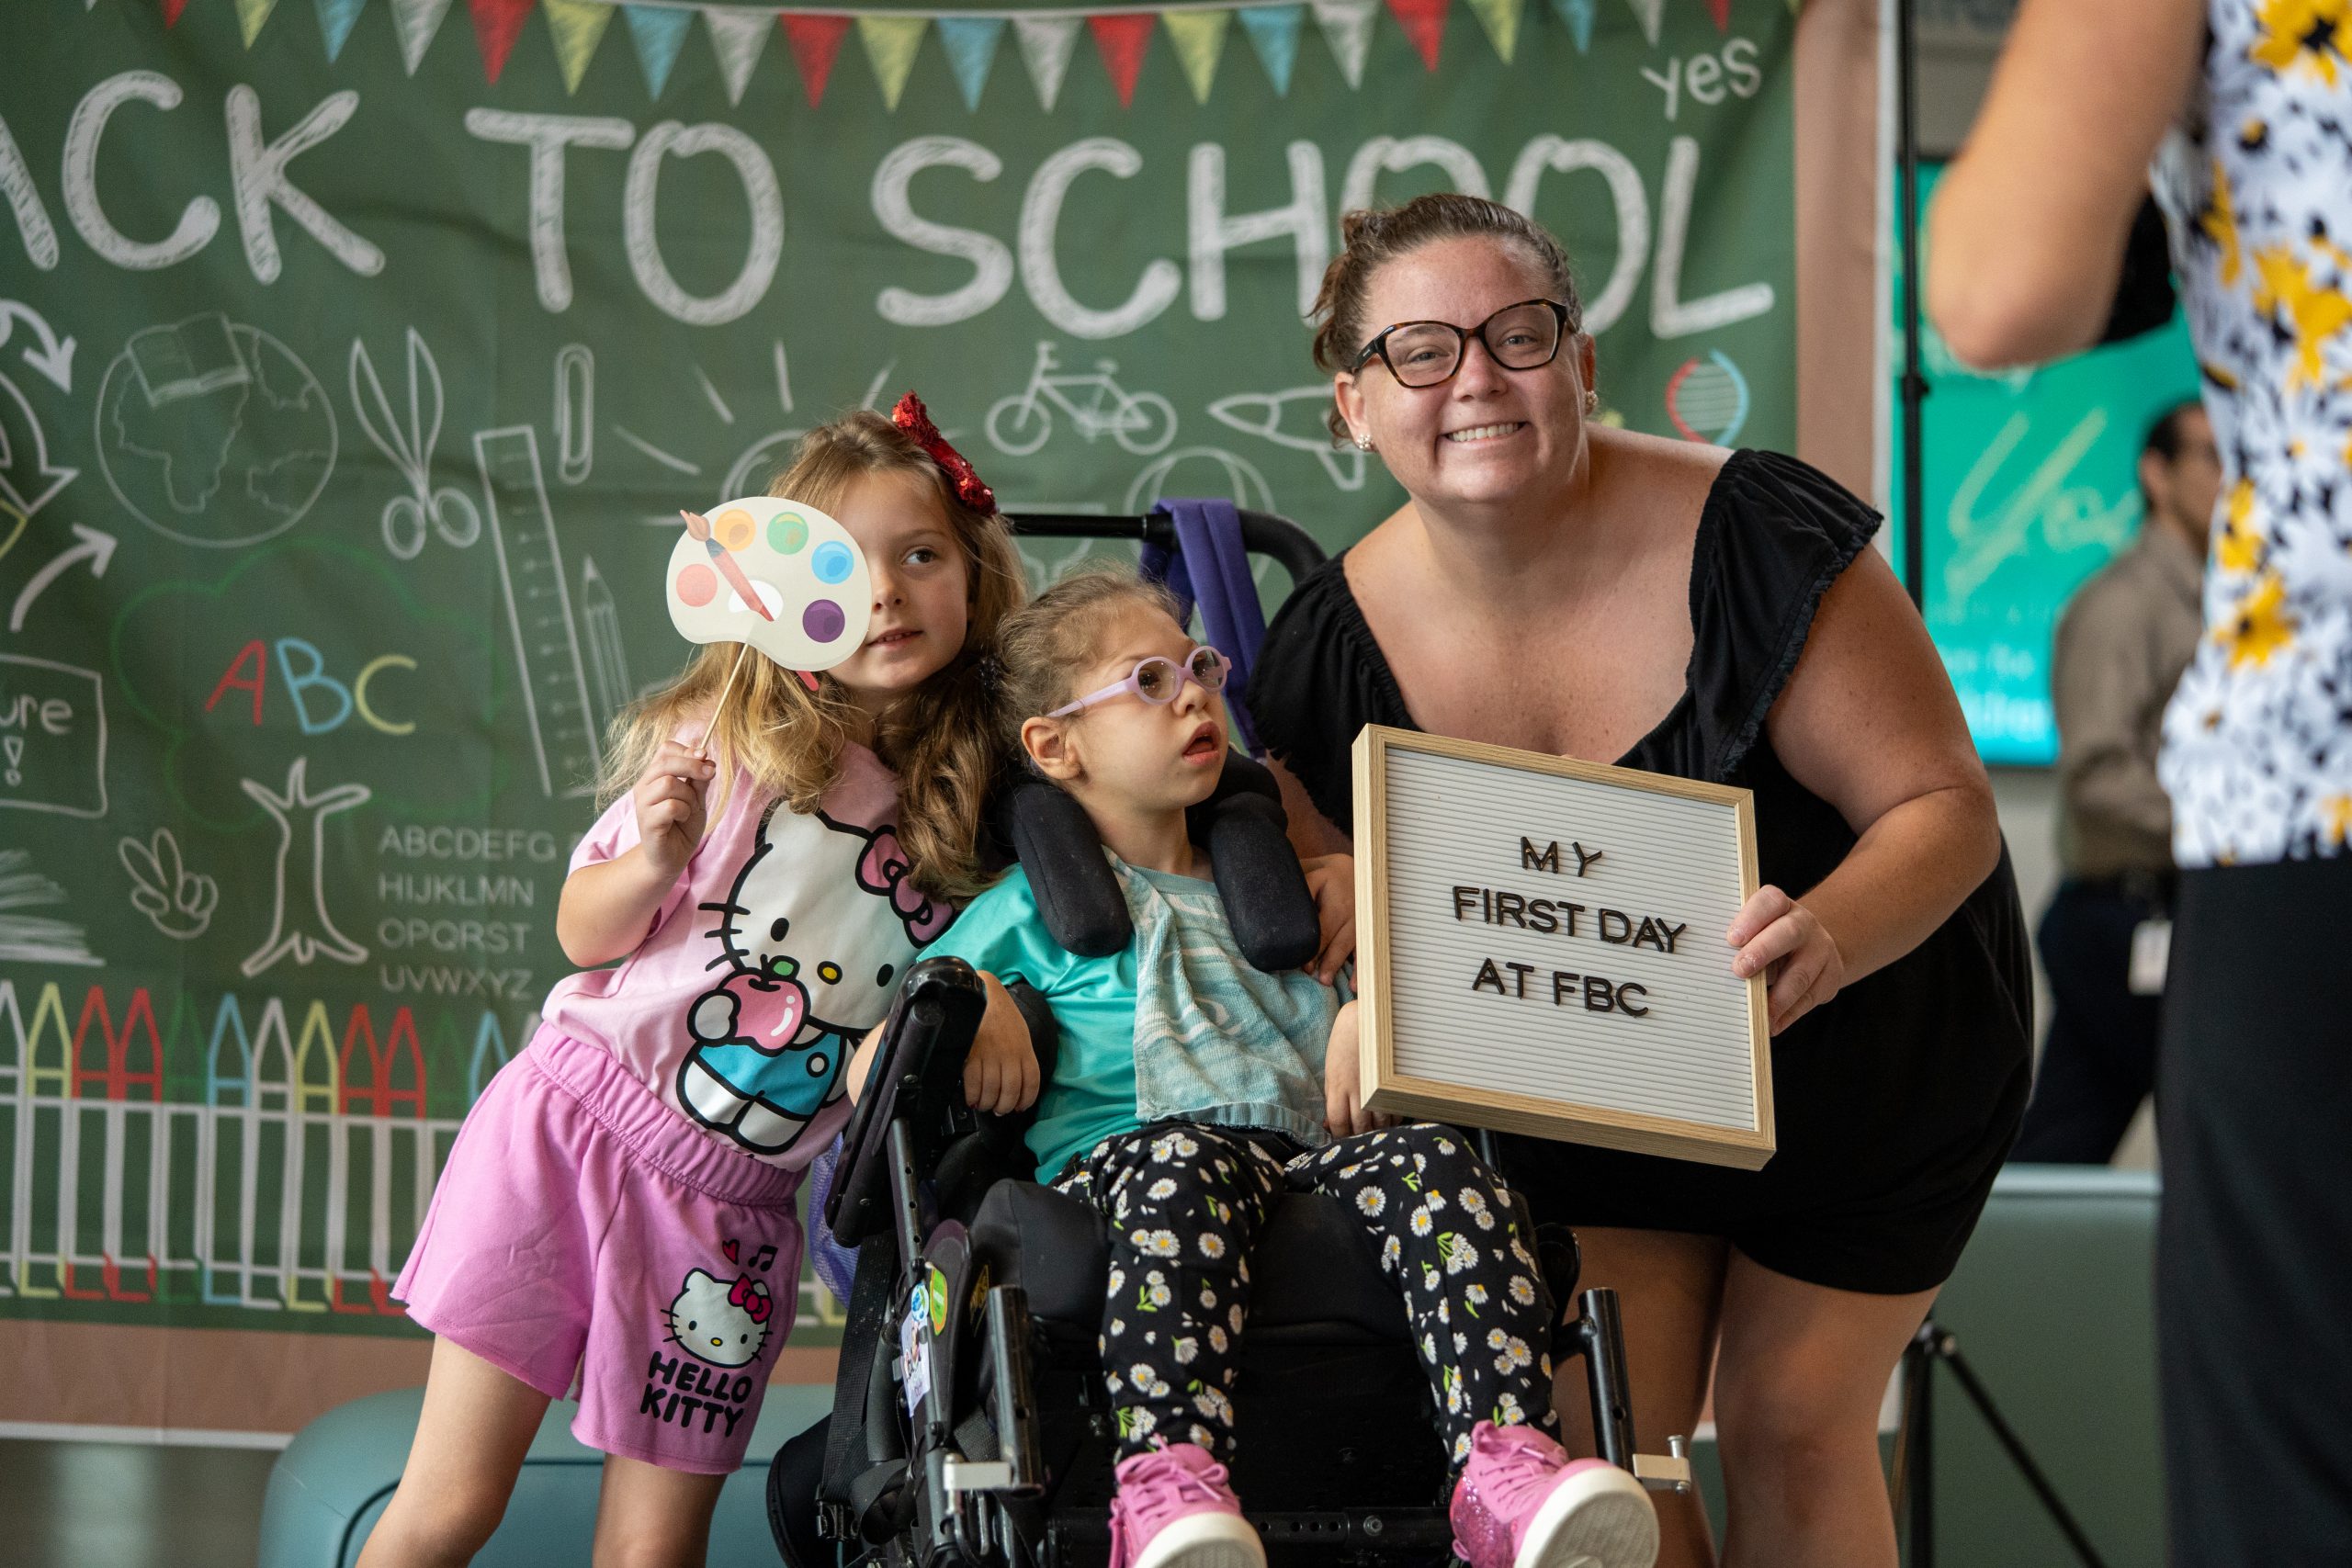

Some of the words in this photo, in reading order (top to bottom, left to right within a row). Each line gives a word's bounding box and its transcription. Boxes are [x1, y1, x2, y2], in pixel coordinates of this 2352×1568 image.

[1640, 38, 1761, 120] yes
[464, 107, 785, 326] TO
[205, 637, 417, 736] ABC
[379, 825, 557, 863] ABCDEFG
[1521, 836, 1602, 877] MY
[379, 873, 534, 908] HIJKLMN
[378, 917, 531, 954] OPQRST
[1453, 886, 1585, 937] FIRST
[1598, 908, 1687, 953] DAY
[380, 964, 533, 1001] UVWXYZ
[1472, 957, 1534, 999] AT
[1553, 970, 1648, 1018] FBC
[648, 1351, 752, 1404] HELLO
[639, 1382, 744, 1438] KITTY
